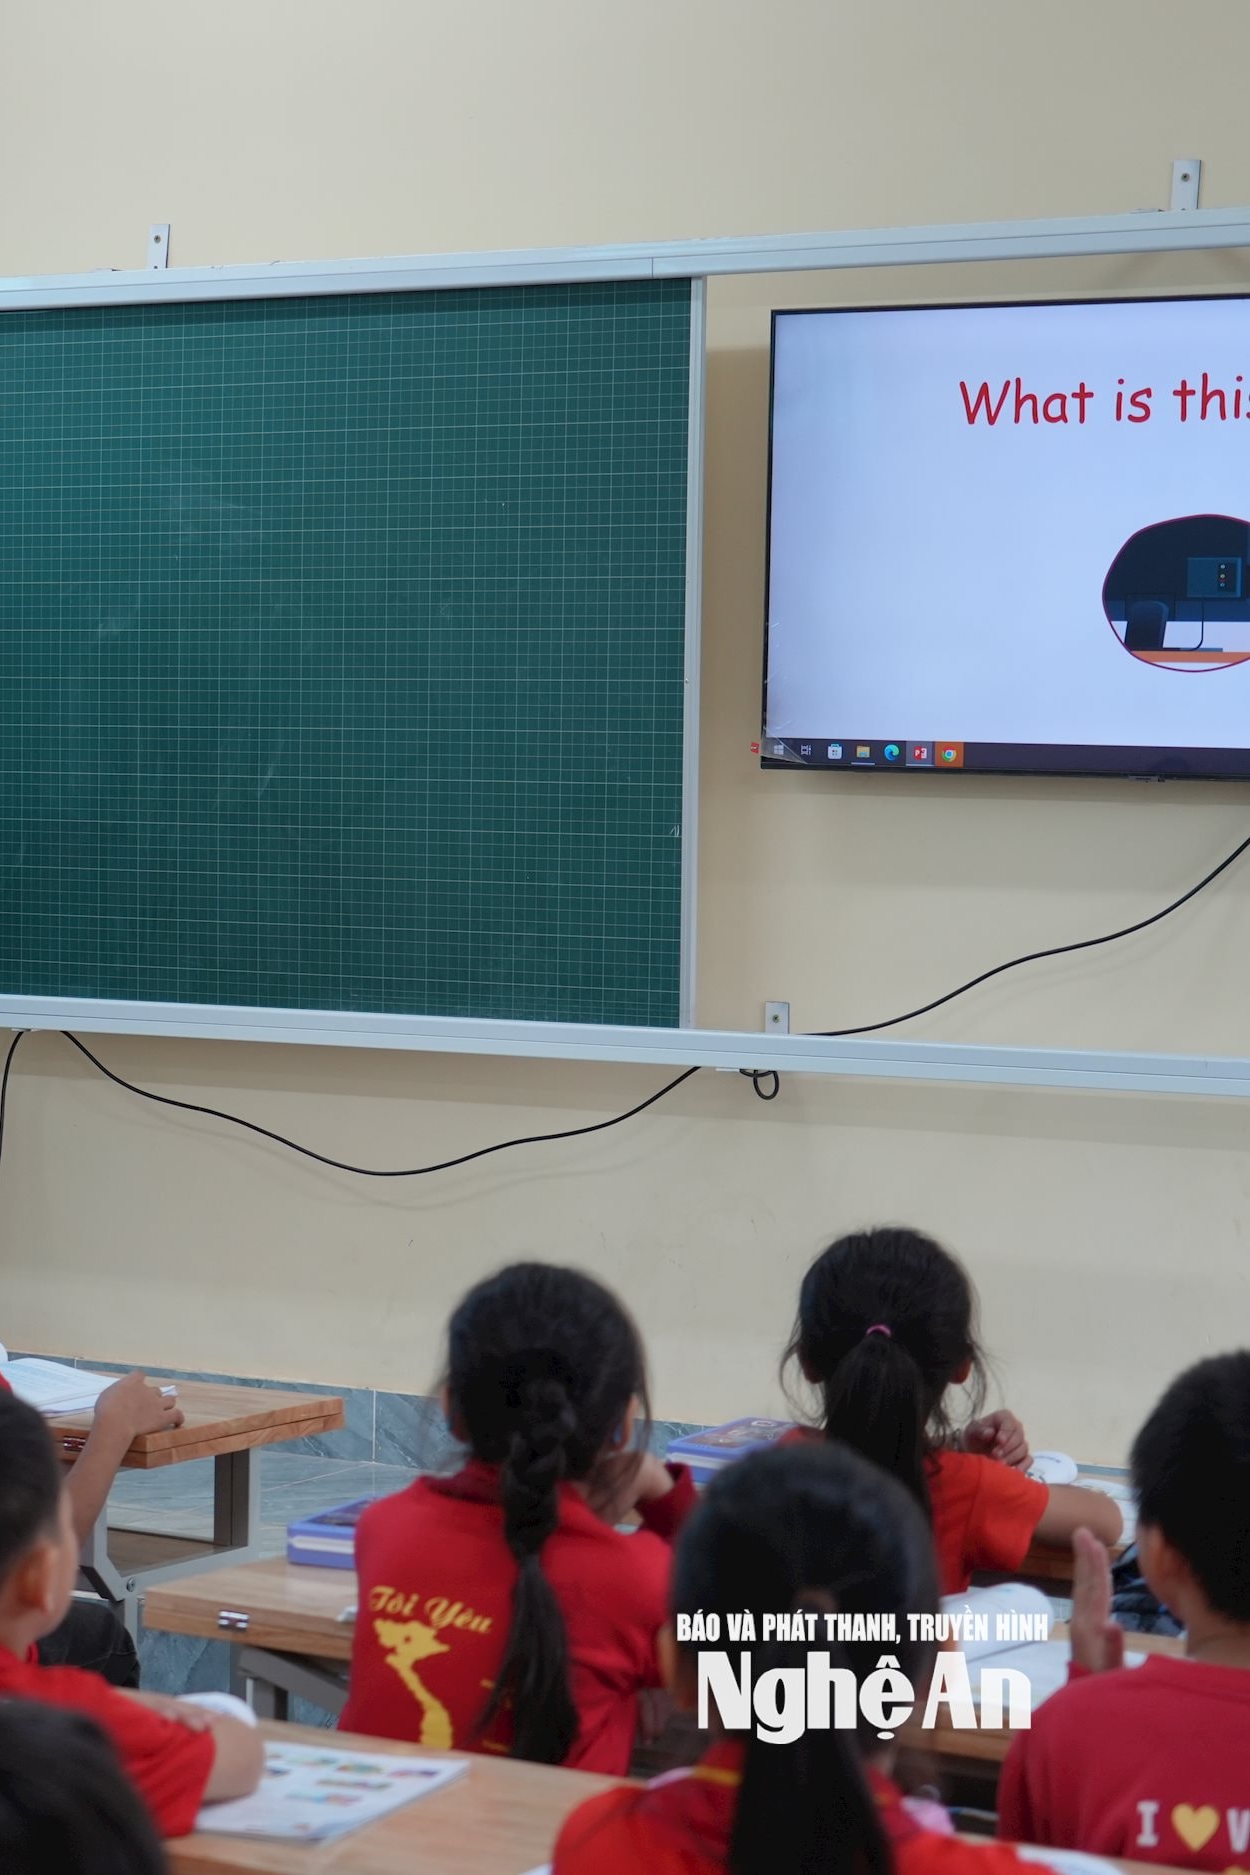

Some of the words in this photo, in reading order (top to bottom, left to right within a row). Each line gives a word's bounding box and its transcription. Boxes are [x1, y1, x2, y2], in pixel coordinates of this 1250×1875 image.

[959, 377, 1094, 425] What
[1116, 378, 1152, 423] is
[1172, 372, 1250, 421] thi
[369, 1585, 419, 1617] Tôi
[424, 1596, 493, 1634] Yêu
[1136, 1800, 1160, 1848] I
